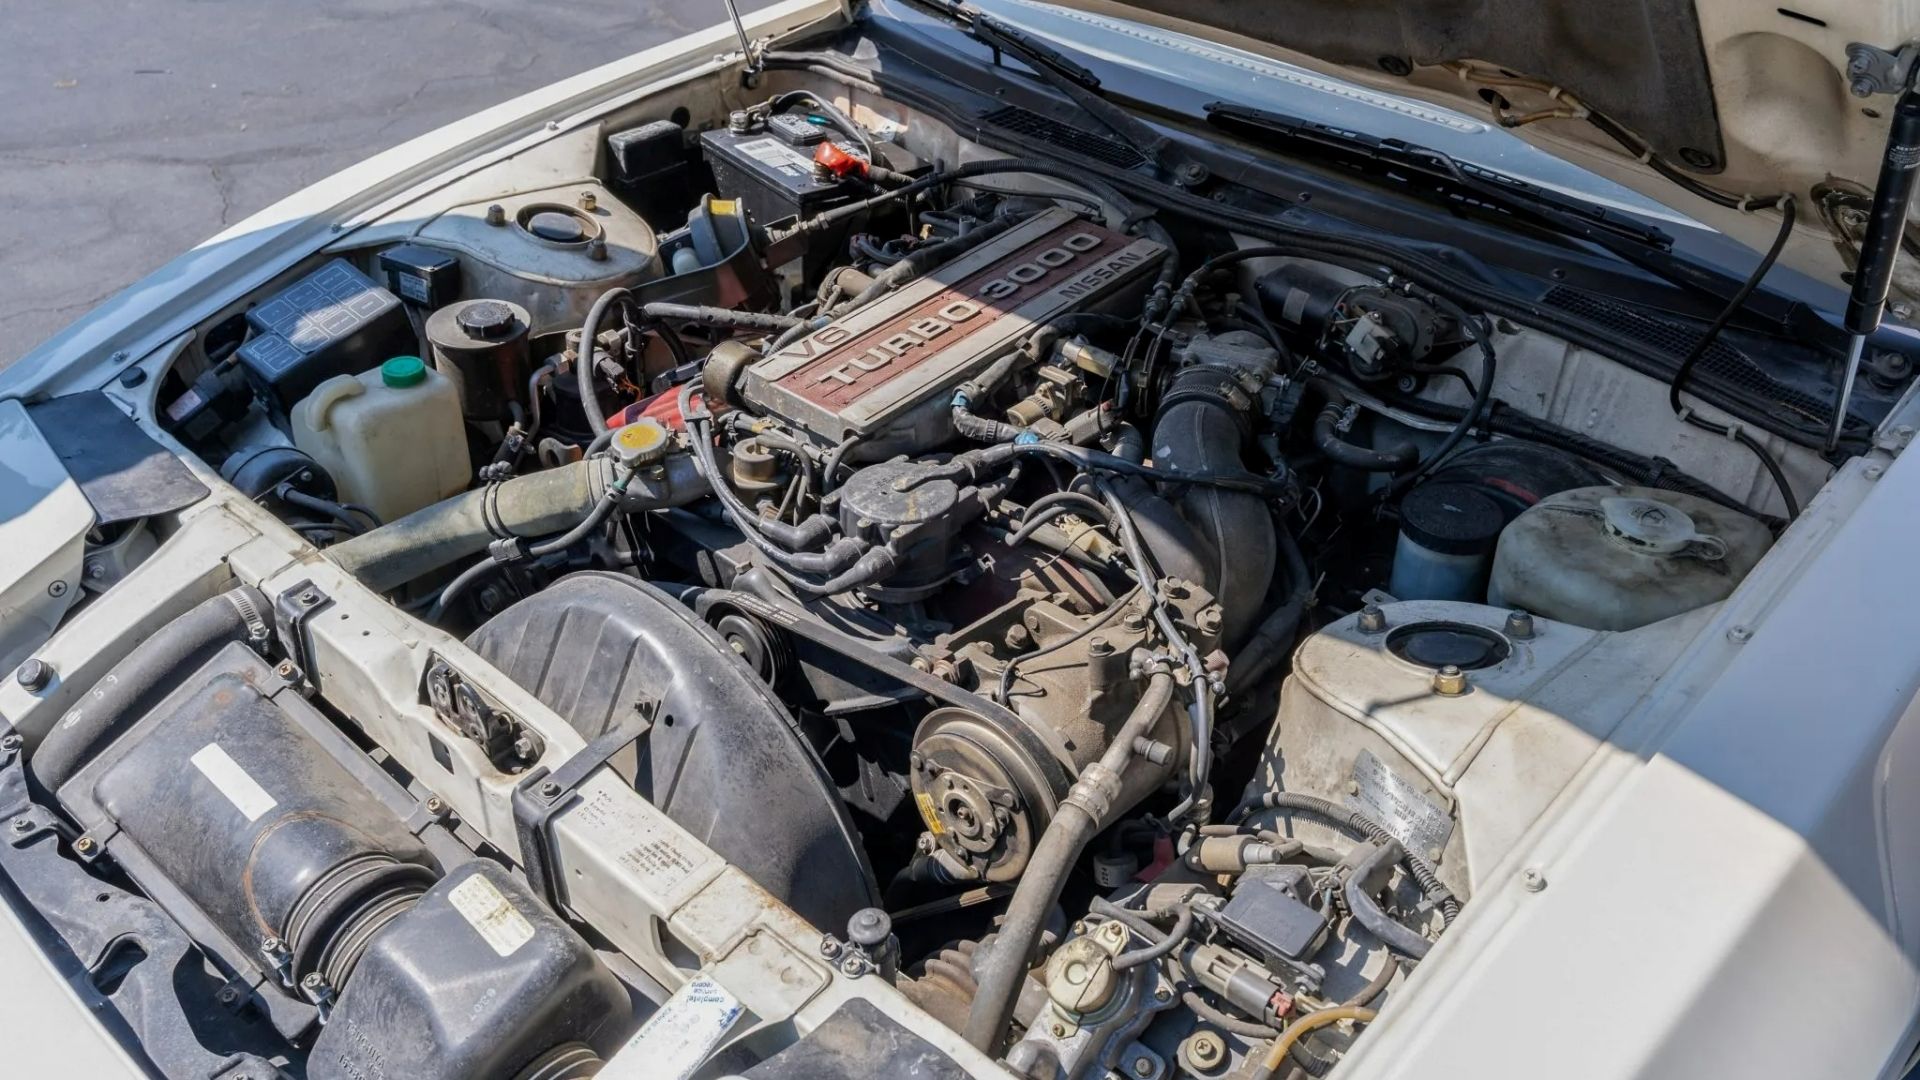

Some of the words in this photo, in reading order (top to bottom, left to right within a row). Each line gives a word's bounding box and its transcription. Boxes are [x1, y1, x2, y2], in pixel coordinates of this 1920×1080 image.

[1059, 252, 1143, 300] NISSAN
[817, 300, 982, 386] TURBO
[979, 233, 1101, 298] 3000
[780, 326, 851, 359] V6
